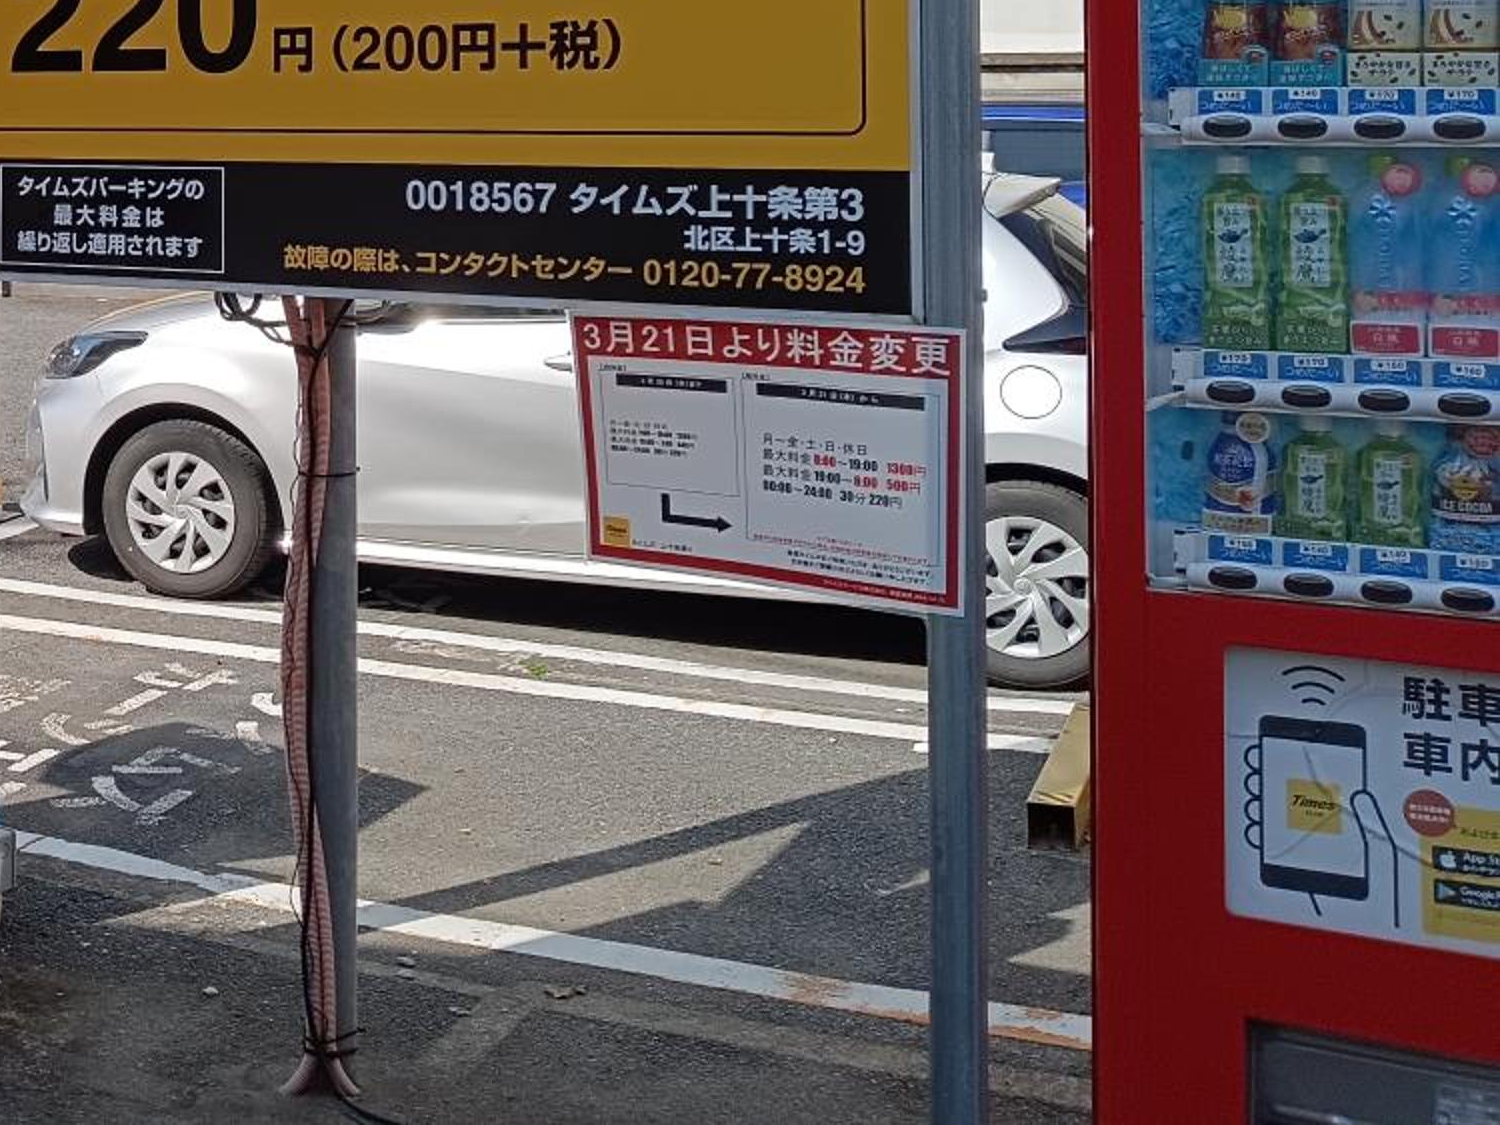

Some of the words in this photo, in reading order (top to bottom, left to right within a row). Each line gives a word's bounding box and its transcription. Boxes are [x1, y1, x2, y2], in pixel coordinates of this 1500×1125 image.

[17, 175, 205, 200] タイムズパーキングの
[405, 179, 553, 214] 0018567
[569, 184, 866, 223] タイムズ上十条第3
[53, 204, 165, 228] 最大料金は
[16, 230, 204, 258] 繰り返し適用されます
[683, 225, 866, 255] 北区上十条1-9
[283, 244, 633, 281] 故障の際は、コンタクトセンター
[642, 259, 867, 294] 0120-77-8924
[582, 321, 951, 377] 3月21日より料金変更
[1402, 676, 1500, 728] 駐車
